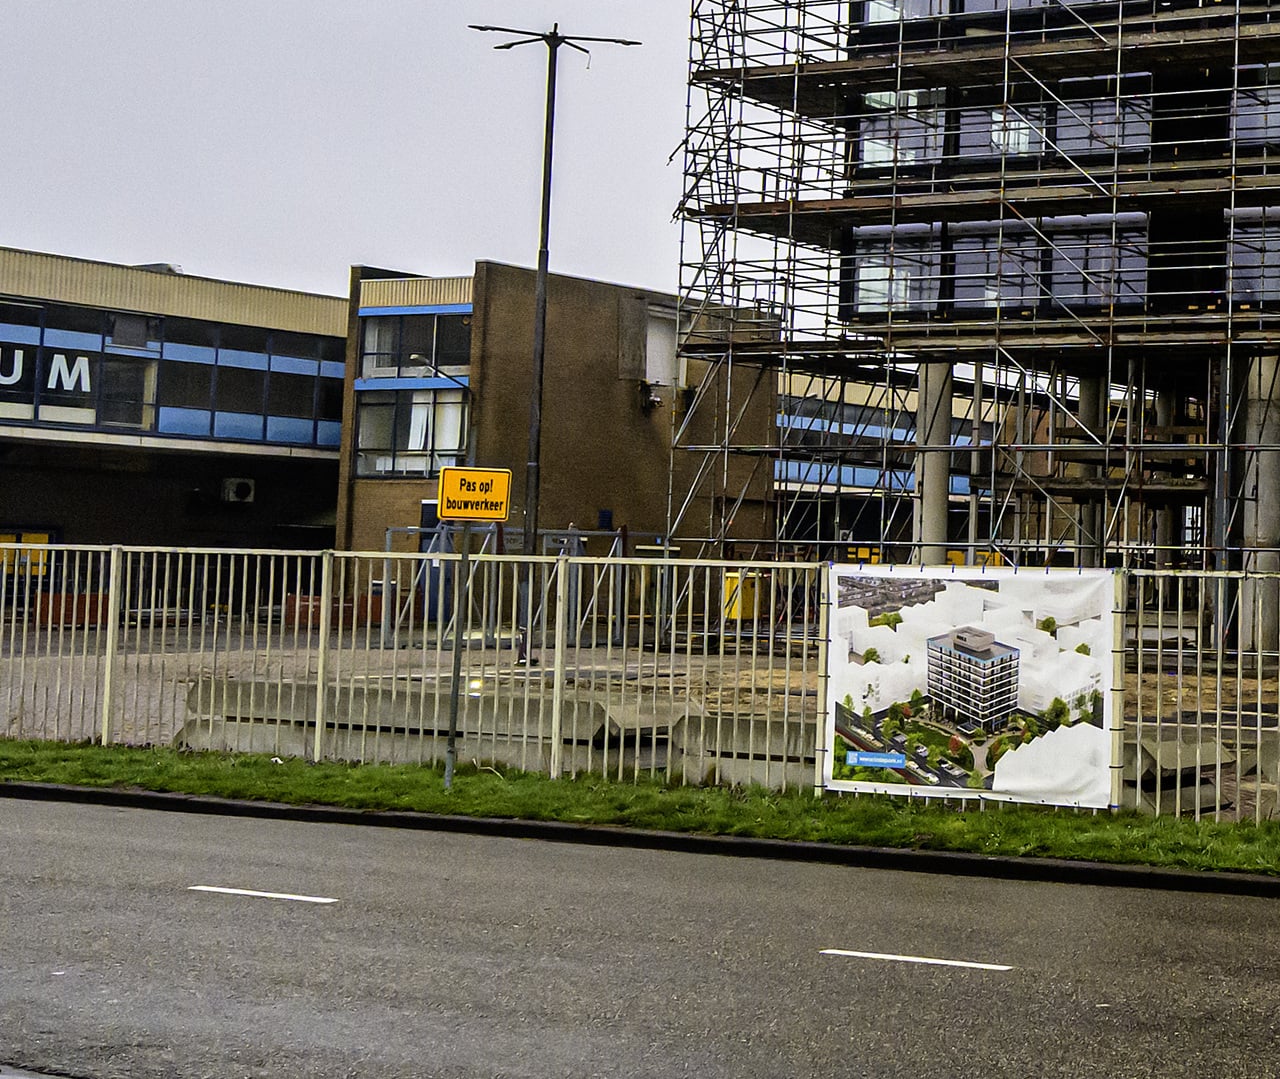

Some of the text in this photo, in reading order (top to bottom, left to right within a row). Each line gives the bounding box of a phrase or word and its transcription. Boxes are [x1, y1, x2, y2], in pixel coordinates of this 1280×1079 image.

[460, 478, 493, 494] Pas op!
[446, 496, 504, 510] bouwverkeer
